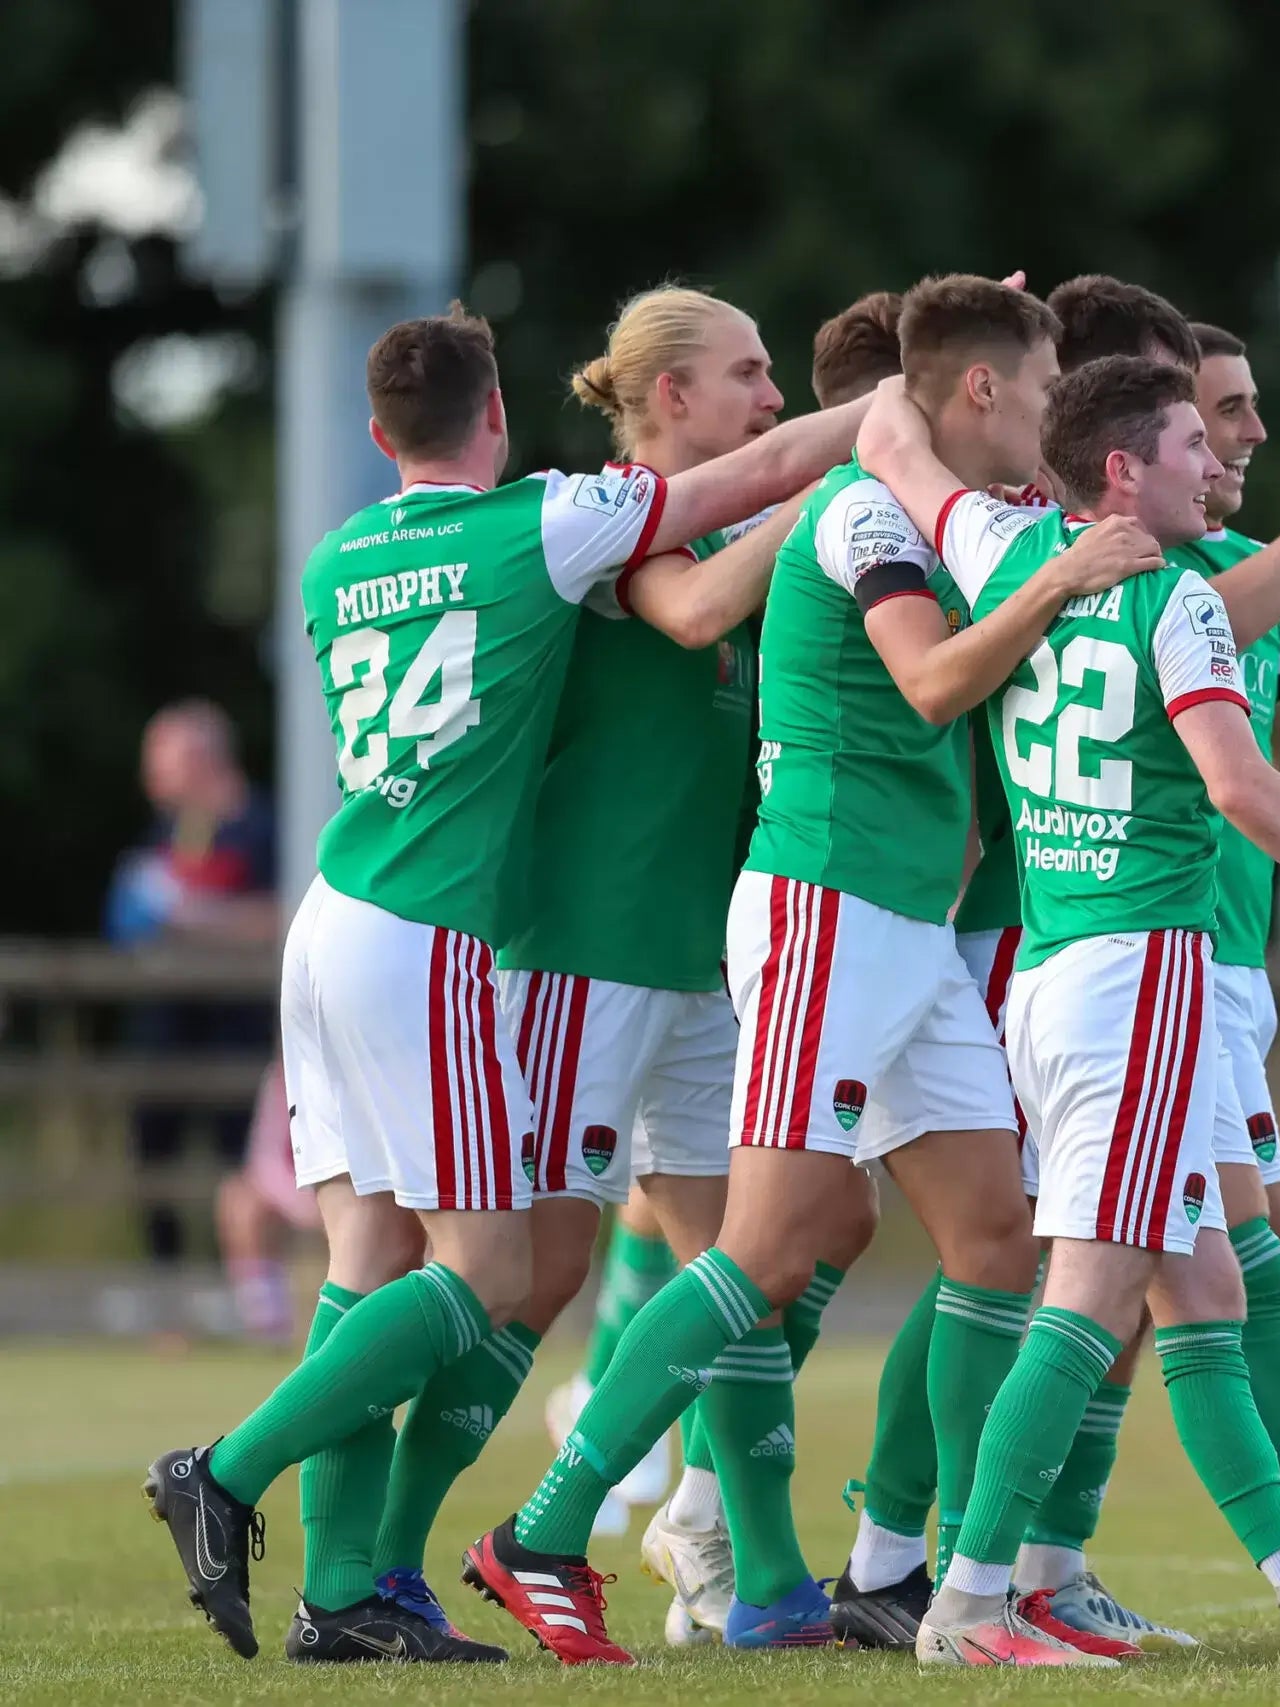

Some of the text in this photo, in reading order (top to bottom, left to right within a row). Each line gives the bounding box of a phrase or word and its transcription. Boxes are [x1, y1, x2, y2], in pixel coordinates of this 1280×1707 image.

[876, 509, 900, 521] sse
[340, 522, 463, 553] MARDYKE ARENA UCC
[852, 542, 900, 561] The Echo
[335, 563, 469, 627] MURPHY
[1209, 640, 1226, 653] The
[330, 610, 482, 792] 24
[1002, 634, 1139, 812] 22
[1016, 798, 1133, 841] Audivox
[1025, 837, 1120, 881] Hearing
[440, 1408, 488, 1440] adida
